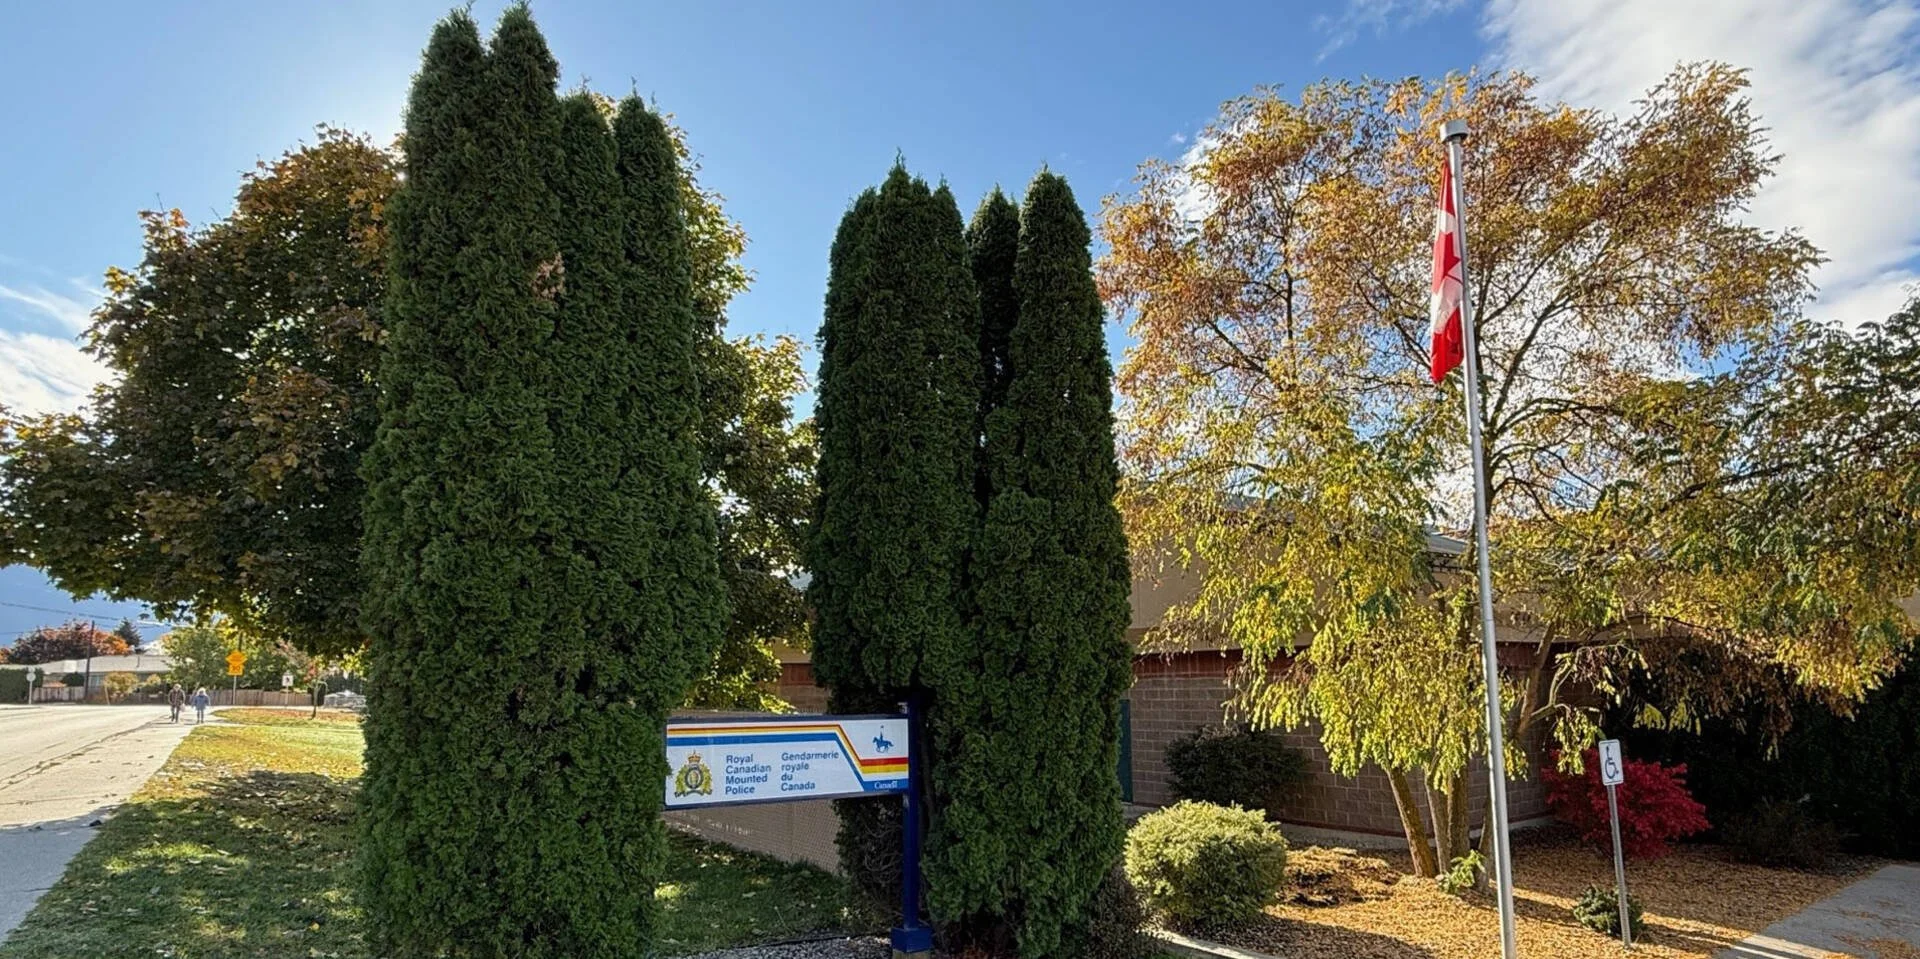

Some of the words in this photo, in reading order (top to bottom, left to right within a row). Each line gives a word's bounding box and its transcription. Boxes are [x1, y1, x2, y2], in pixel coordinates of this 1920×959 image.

[726, 754, 753, 765] Royal
[781, 752, 839, 761] Gendarmerie
[725, 764, 771, 774] Canadian
[781, 762, 809, 772] royale
[725, 774, 768, 784] Mounted
[781, 773, 793, 781] du
[781, 782, 815, 791] Canada
[874, 780, 897, 789] Canada
[725, 785, 755, 795] Police
